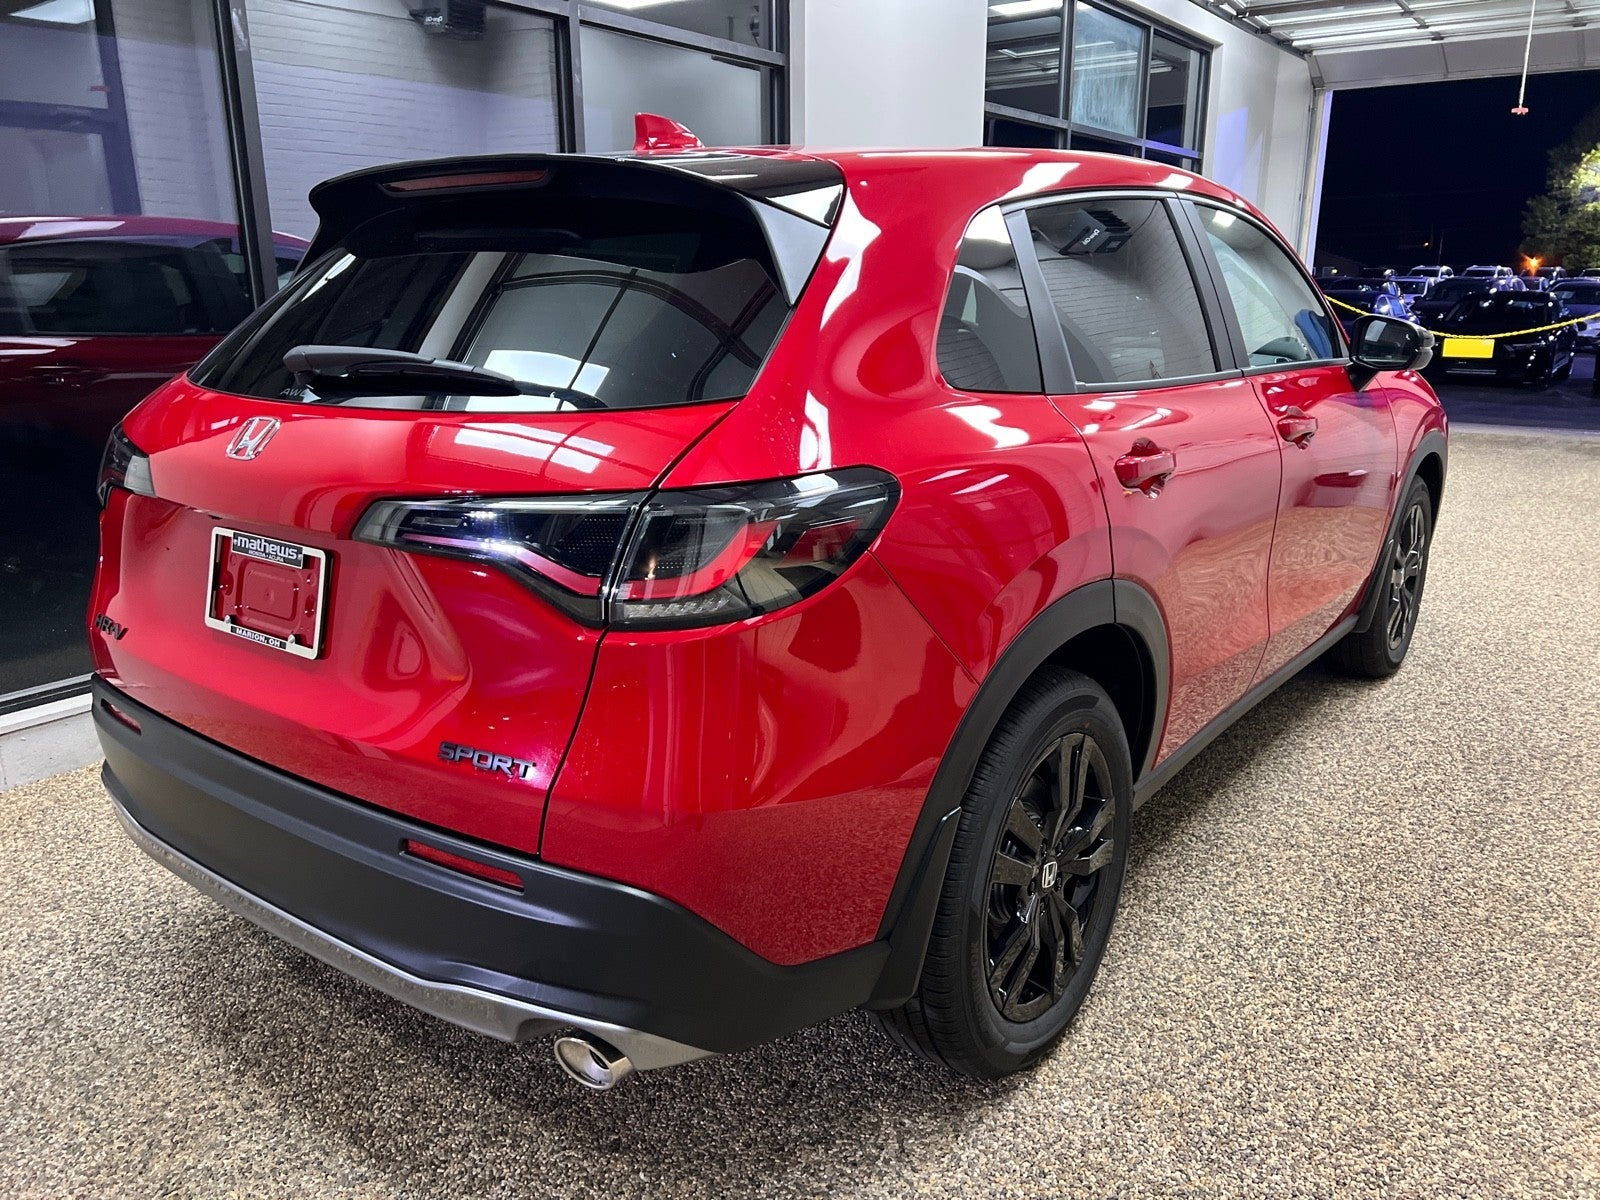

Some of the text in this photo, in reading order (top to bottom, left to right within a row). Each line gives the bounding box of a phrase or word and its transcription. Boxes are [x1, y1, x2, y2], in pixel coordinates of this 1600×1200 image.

[237, 536, 298, 560] mathews
[236, 627, 281, 647] MARION, OH
[438, 741, 537, 779] SPORT
